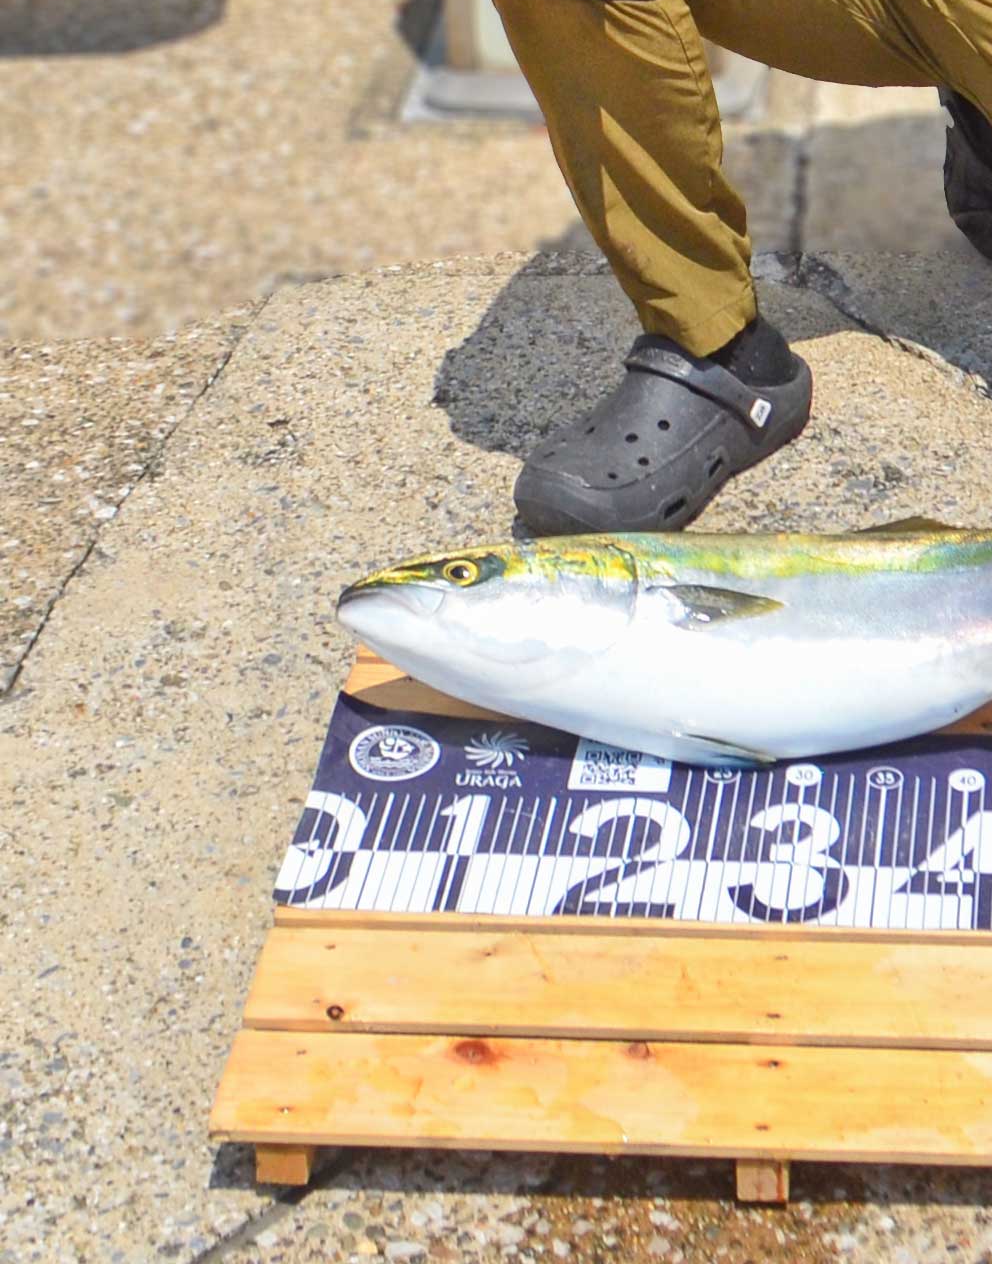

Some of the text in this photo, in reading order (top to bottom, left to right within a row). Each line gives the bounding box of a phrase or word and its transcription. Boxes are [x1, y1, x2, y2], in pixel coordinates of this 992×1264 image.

[432, 794, 491, 911] 1
[552, 797, 691, 919] 2
[727, 803, 851, 923] 3
